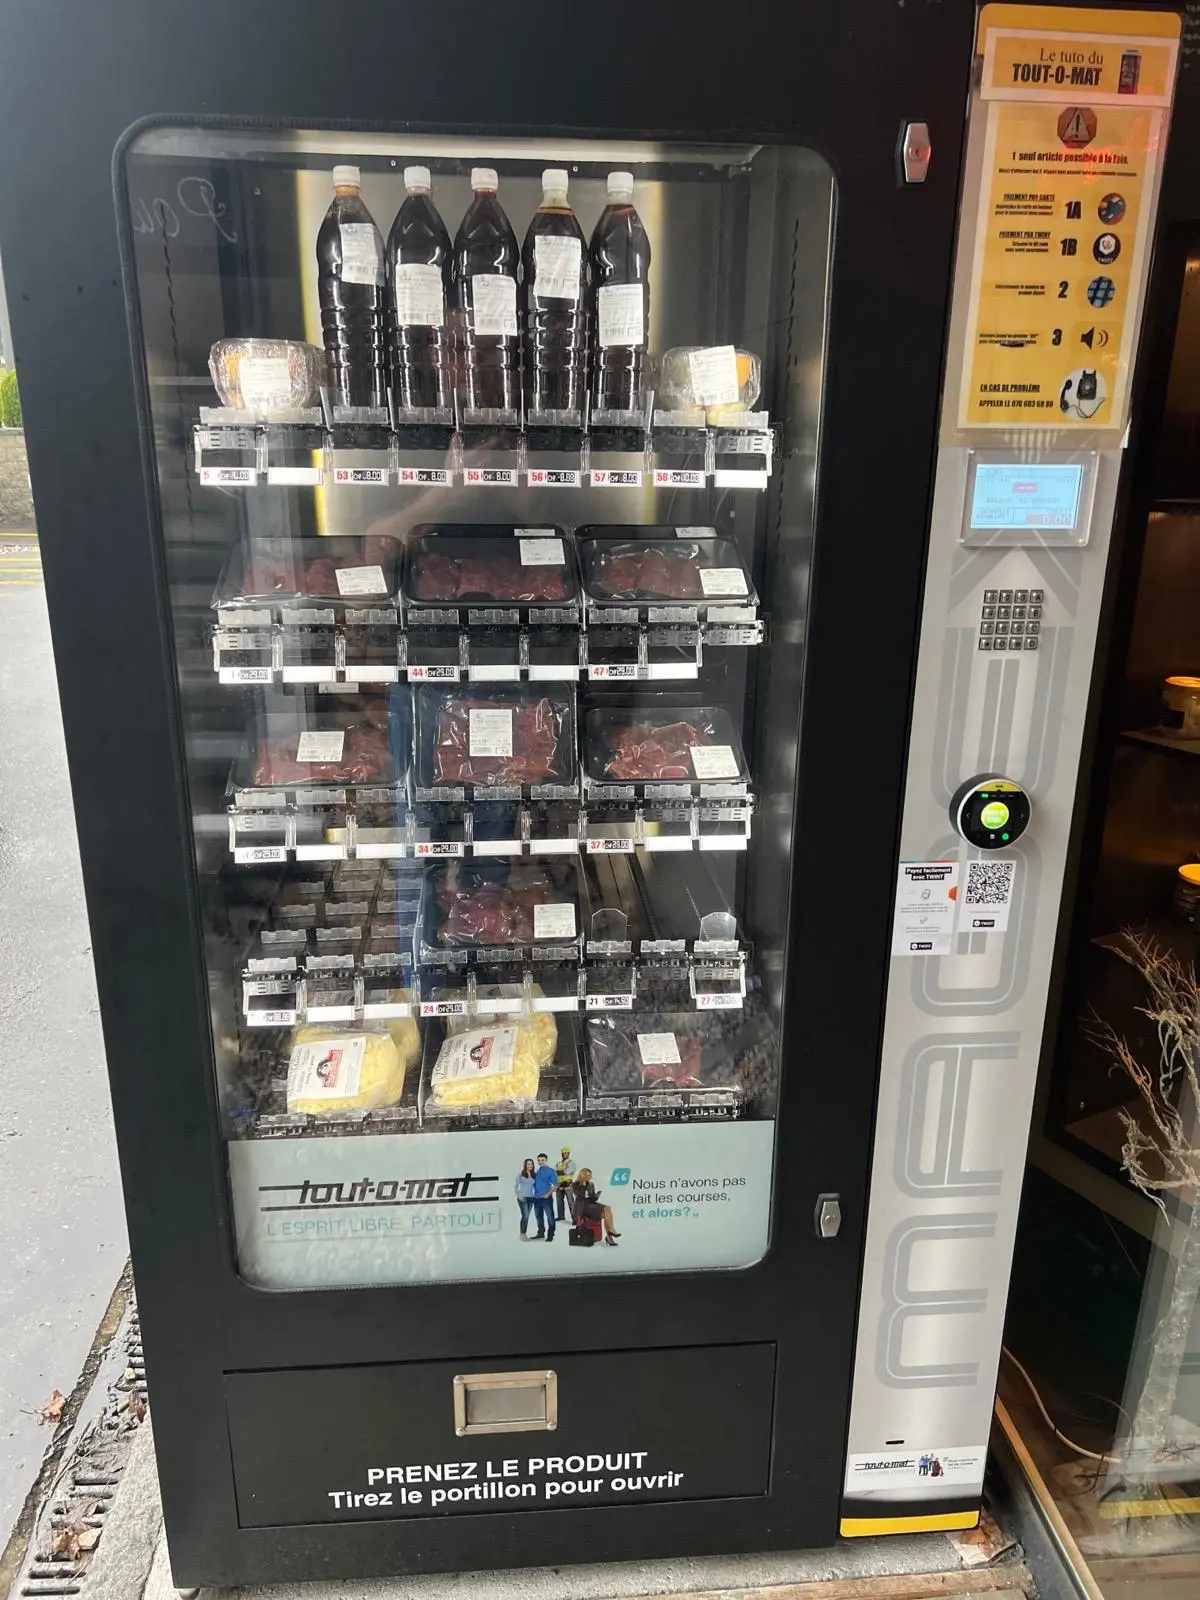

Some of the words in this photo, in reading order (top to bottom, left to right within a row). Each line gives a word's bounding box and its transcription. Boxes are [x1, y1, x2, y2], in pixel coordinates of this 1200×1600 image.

[1039, 47, 1056, 63] Le
[1060, 50, 1085, 64] tuto
[1088, 50, 1104, 65] du
[1012, 63, 1103, 87] TOUT-O-MAT
[1012, 151, 1017, 161] 1
[1018, 151, 1036, 162] seul
[1037, 152, 1063, 162] article
[1064, 153, 1098, 164] possible
[1105, 153, 1112, 164] la
[1064, 200, 1082, 220] 1A
[1060, 238, 1078, 257] 1B
[1057, 280, 1070, 299] 2
[1051, 328, 1064, 347] 3
[988, 384, 1001, 392] CAS
[1002, 384, 1010, 392] DE
[337, 470, 349, 480] 53
[402, 470, 414, 480] 54
[468, 471, 480, 480] 55
[532, 472, 543, 481] 56
[594, 472, 606, 482] 57
[657, 472, 668, 482] 58
[412, 668, 424, 677] 44
[593, 667, 604, 676] 47
[418, 845, 429, 854] 34
[590, 840, 601, 849] 37
[701, 996, 710, 1005] 27
[298, 1172, 473, 1205] tout-o-mat
[632, 1179, 665, 1190] Nous
[670, 1178, 719, 1188] n'avons
[722, 1177, 746, 1188] pas
[632, 1194, 652, 1204] fait
[655, 1193, 673, 1204] les
[676, 1192, 731, 1203] courses,
[632, 1208, 645, 1218] et
[411, 1212, 495, 1230] PARTOUT
[367, 1461, 478, 1486] PRENEZ
[486, 1458, 520, 1479] LE
[528, 1451, 648, 1476] PRODUIT
[328, 1490, 393, 1509] Tirez
[400, 1487, 423, 1505] le
[430, 1480, 537, 1507] portillon
[545, 1477, 604, 1500] pour
[610, 1470, 684, 1492] ouvrir
